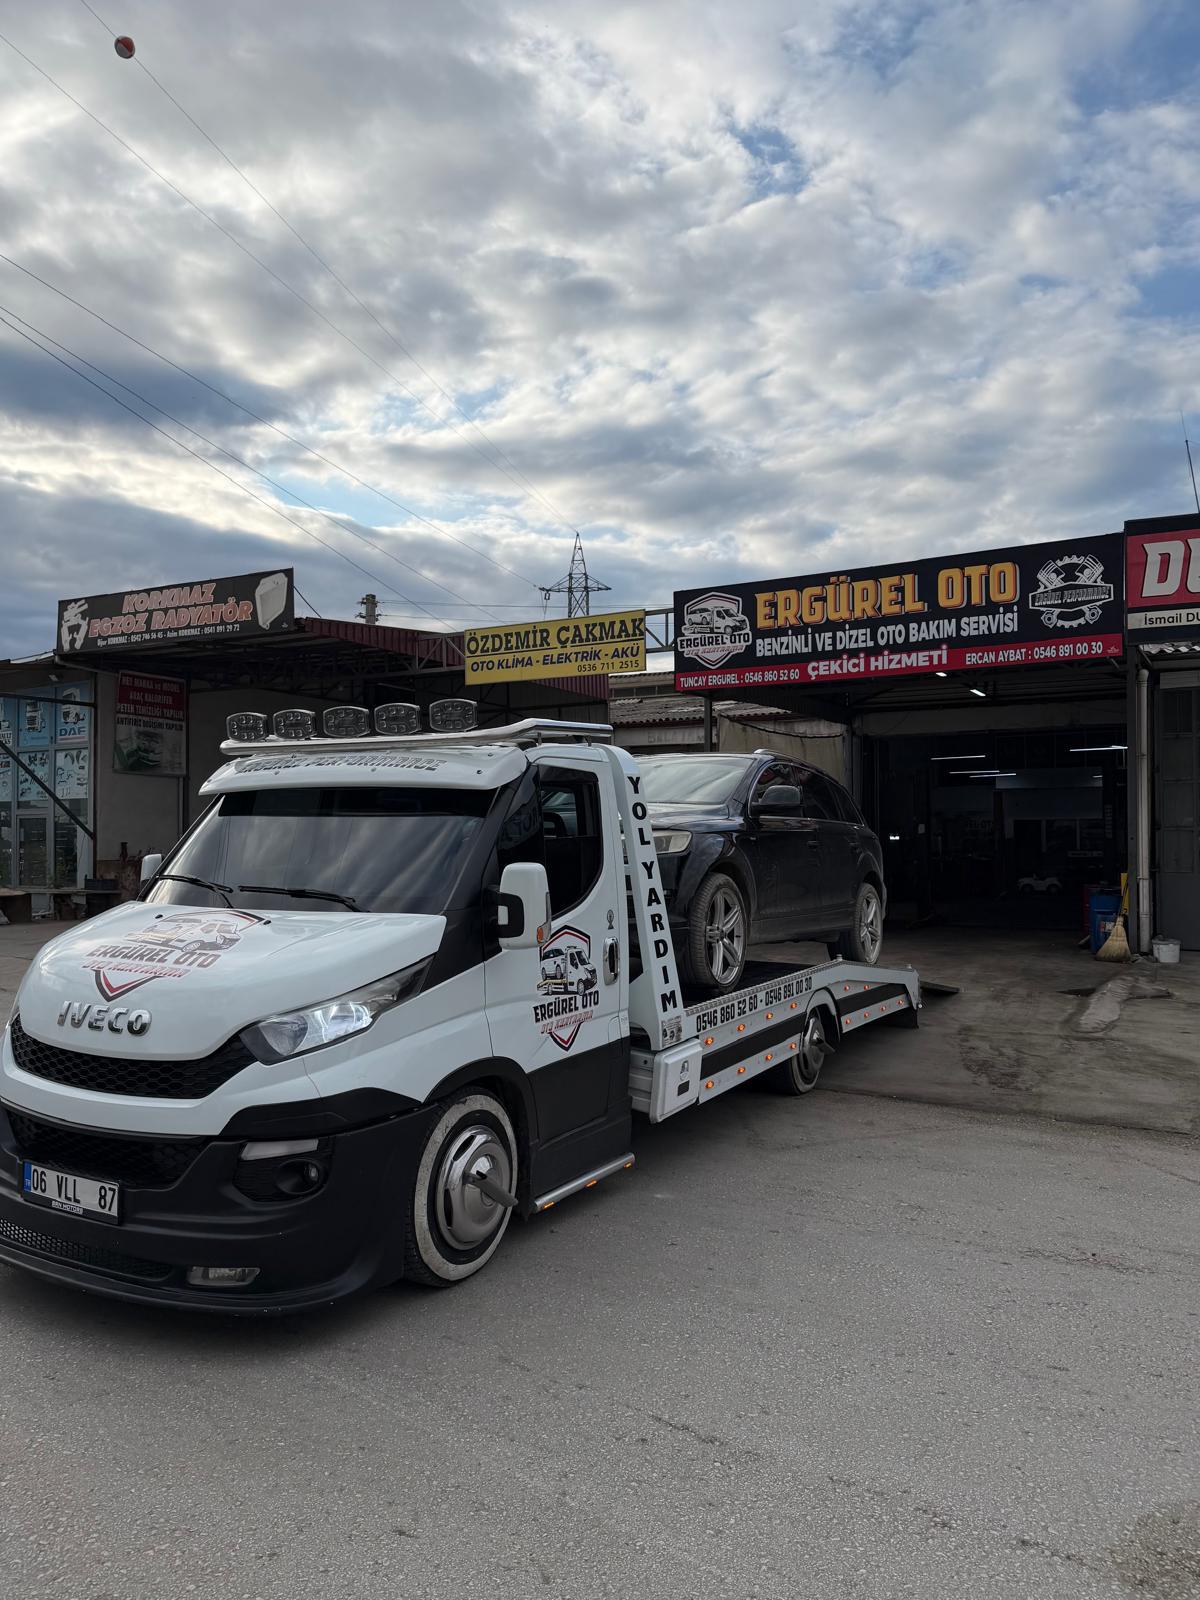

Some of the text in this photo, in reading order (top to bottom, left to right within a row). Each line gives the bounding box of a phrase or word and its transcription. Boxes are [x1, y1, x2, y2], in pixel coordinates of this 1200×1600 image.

[122, 583, 216, 614] KORKMAZ
[755, 561, 1020, 631] ERGÜREL OTO
[88, 597, 253, 638] EGZOZ RADYATÖR
[756, 605, 1018, 657] BENZİNLİ VE DİZEL OTO BAKIM SERVİSİ
[1144, 613, 1182, 626] İsmail
[467, 617, 645, 655] ÖZDEMİR ÇAKMAK
[679, 632, 750, 649] ERGÜREL OTO
[965, 651, 995, 665] ERCAN
[998, 648, 1026, 662] AYBAT
[1033, 645, 1056, 659] 0546
[1059, 643, 1073, 657] 891
[1076, 642, 1088, 655] 00
[1091, 641, 1103, 654] 30
[471, 660, 494, 673] OTO
[497, 654, 533, 670] KLİMA
[542, 648, 602, 666] ELEKTRİK
[611, 643, 640, 659] AKÜ
[577, 660, 640, 673] 0536 711 2515
[807, 644, 948, 680] ÇEKİCİ HİZMETİ
[680, 676, 706, 688] TUNCAY
[745, 671, 763, 683] 0546
[764, 670, 777, 682] 860
[780, 669, 788, 680] 52
[789, 668, 799, 679] 60
[59, 726, 86, 736] DAF
[627, 776, 650, 846] YOL
[641, 861, 677, 1012] YARDIM
[86, 945, 221, 968] ERGÜREL OTO
[57, 1000, 152, 1036] IVECO
[533, 990, 599, 1023] ERGÜREL OTO
[696, 1009, 718, 1032] 0546
[720, 1003, 735, 1023] 860
[737, 998, 746, 1016] 52
[748, 994, 757, 1011] 60
[765, 986, 781, 1006] 0546
[784, 982, 794, 999] 891
[796, 978, 803, 994] 00
[805, 976, 812, 991] 30
[32, 1168, 116, 1212] 06 VLL 87
